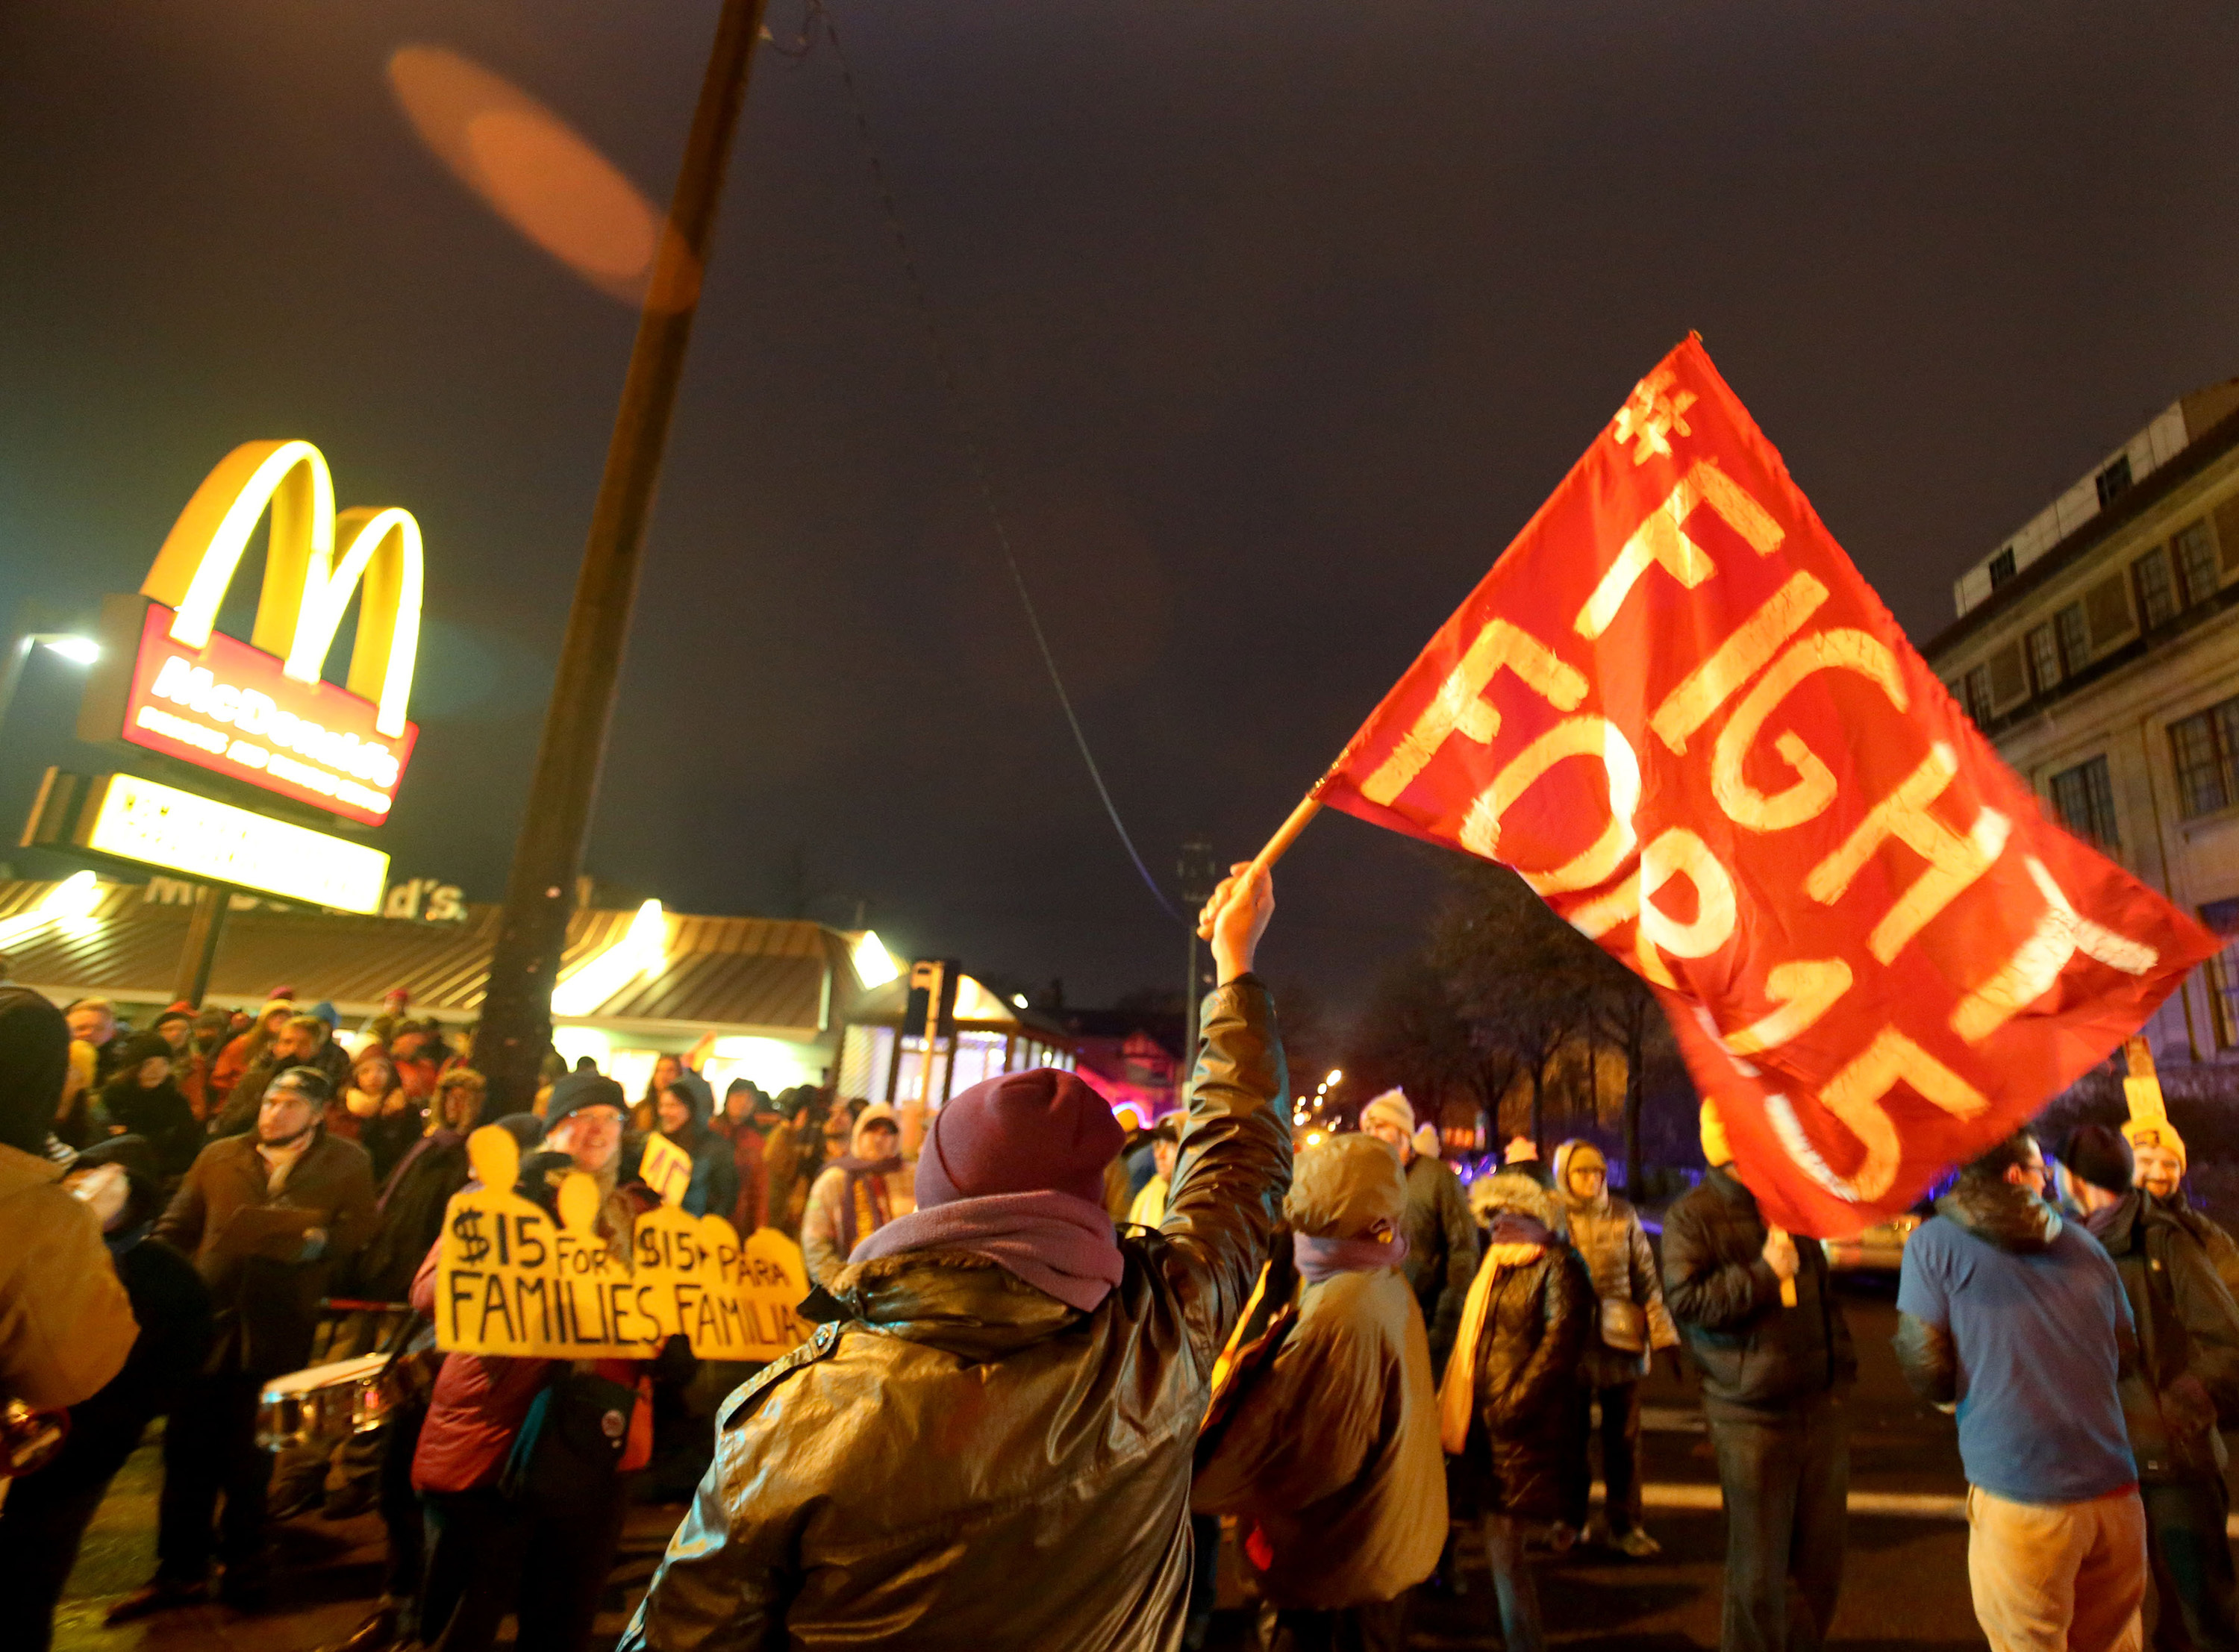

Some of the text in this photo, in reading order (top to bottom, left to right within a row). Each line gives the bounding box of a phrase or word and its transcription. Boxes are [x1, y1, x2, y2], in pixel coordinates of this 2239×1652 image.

[1361, 618, 1737, 989] FOR
[452, 1207, 611, 1275] $15 FOR
[640, 1227, 790, 1287] $15 PARA
[450, 1270, 662, 1345] FAMILIES
